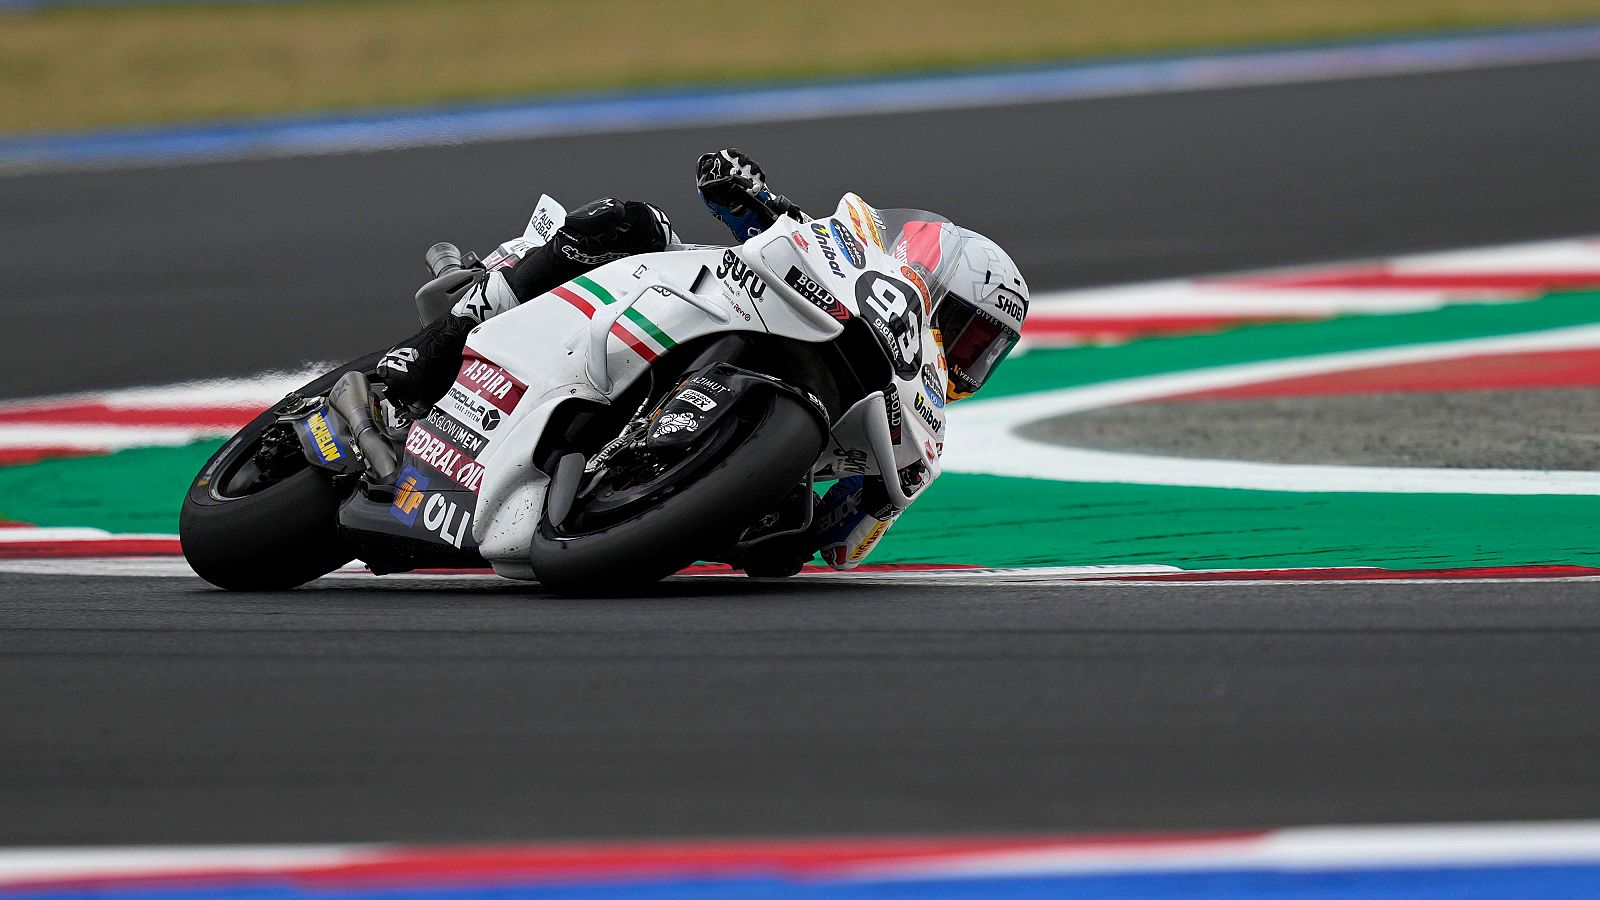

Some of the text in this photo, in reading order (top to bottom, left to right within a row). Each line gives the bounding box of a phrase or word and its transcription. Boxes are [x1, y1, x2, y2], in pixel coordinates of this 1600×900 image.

[540, 213, 554, 229] AUS
[797, 273, 835, 305] BOLD
[865, 278, 920, 364] 93
[463, 359, 513, 399] ASPIRA
[448, 387, 485, 416] MODULA
[891, 389, 900, 426] BOLD
[307, 411, 341, 462] MICHELIN
[406, 426, 484, 491] FEDERAL OIL
[424, 493, 471, 549] OLI
